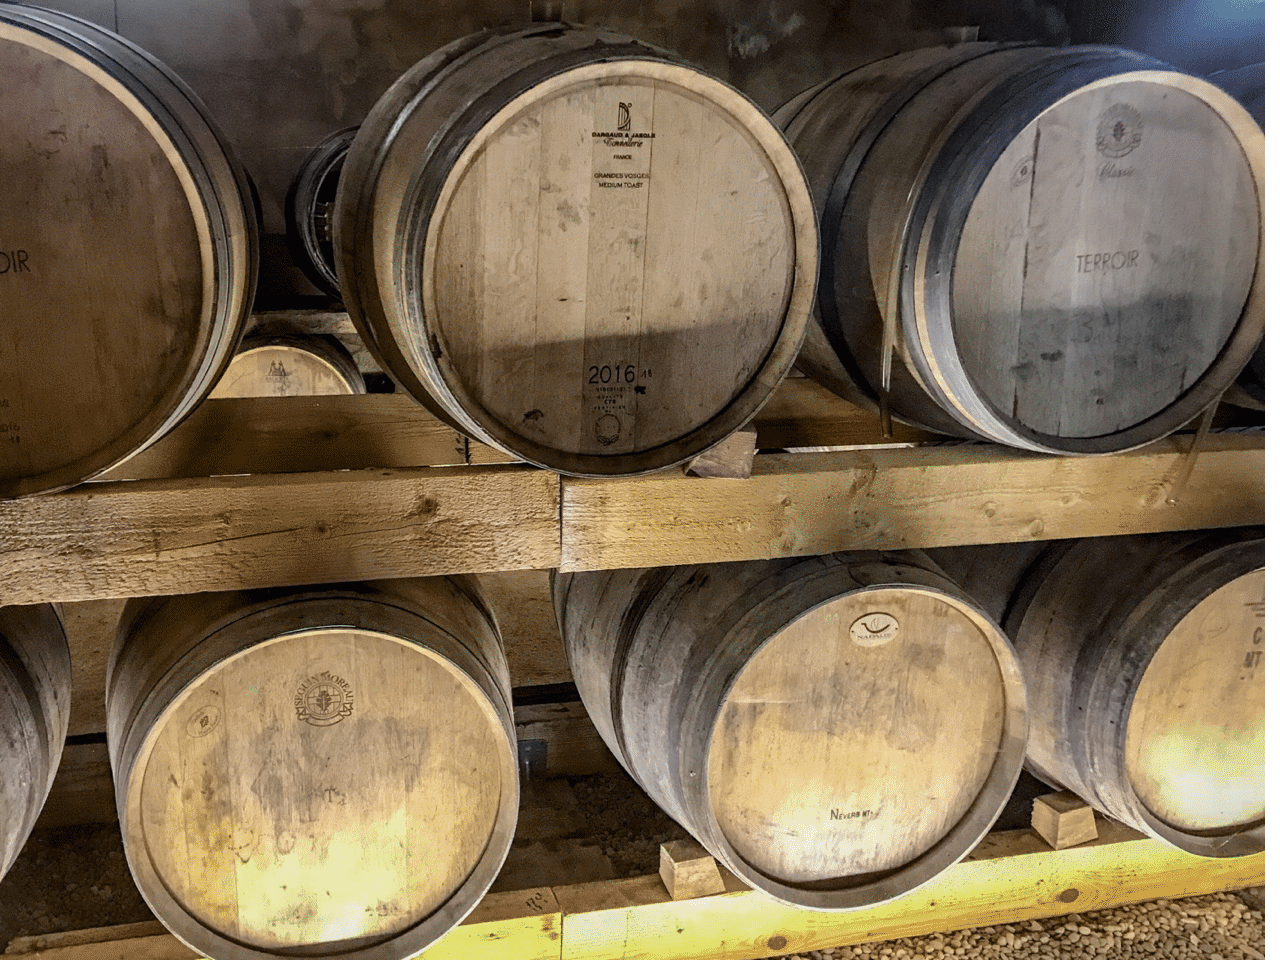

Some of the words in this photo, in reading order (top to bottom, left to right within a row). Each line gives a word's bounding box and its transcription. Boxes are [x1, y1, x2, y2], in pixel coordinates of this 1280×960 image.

[1076, 249, 1139, 273] TERROIR
[588, 365, 635, 384] 2016
[294, 674, 320, 707] SEGUIN
[320, 670, 353, 702] MOREAU
